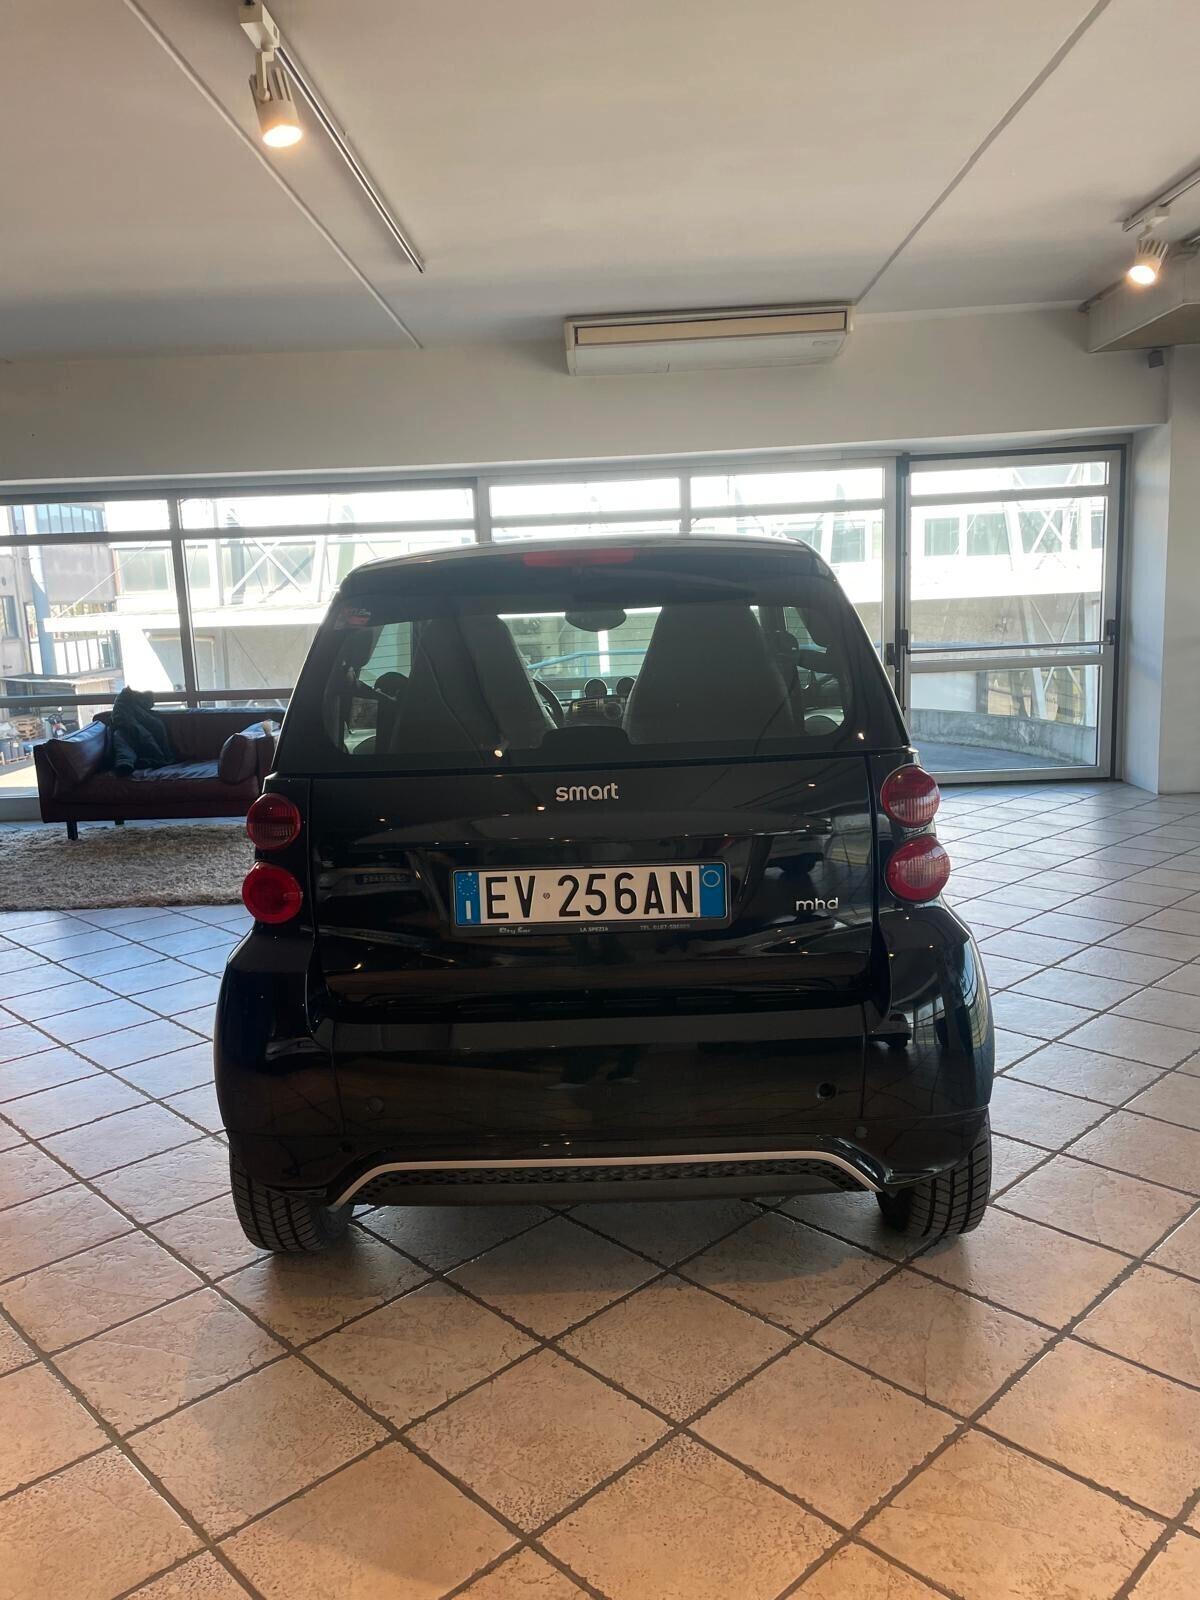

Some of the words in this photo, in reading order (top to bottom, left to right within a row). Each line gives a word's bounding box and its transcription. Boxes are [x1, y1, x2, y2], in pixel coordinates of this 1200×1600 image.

[555, 782, 619, 801] smart
[485, 875, 536, 919] EV
[557, 870, 694, 918] 256AN
[795, 896, 839, 912] mhd
